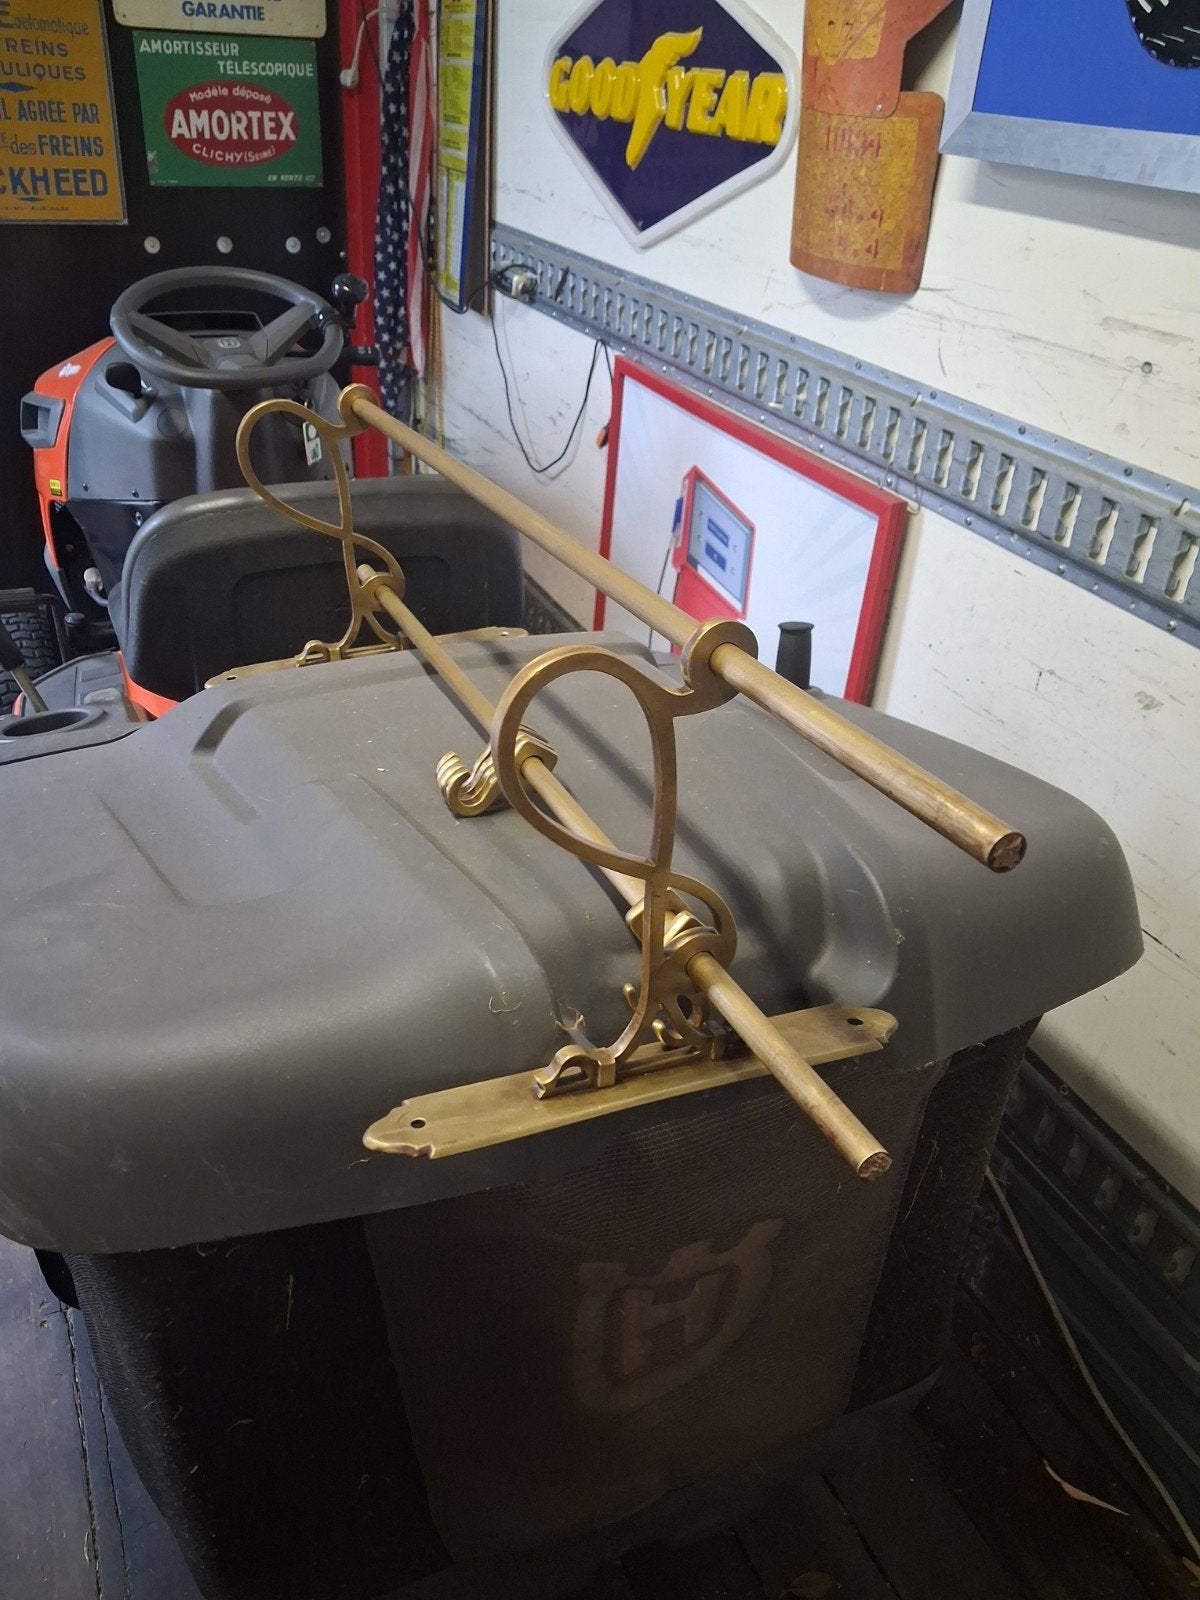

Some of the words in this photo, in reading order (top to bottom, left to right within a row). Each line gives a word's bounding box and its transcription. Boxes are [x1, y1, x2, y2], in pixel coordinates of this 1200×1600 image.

[182, 0, 266, 22] GARANTIE
[13, 13, 89, 38] automatique
[139, 38, 240, 57] AMORTISSEUR
[189, 84, 230, 104] Modèle
[232, 85, 273, 104] déposé
[549, 54, 788, 147] GOODYEAR
[72, 102, 100, 124] PAR
[171, 108, 296, 141] AMORTEX
[10, 134, 37, 156] des
[38, 134, 105, 157] FREINS
[192, 143, 242, 163] CLICHY
